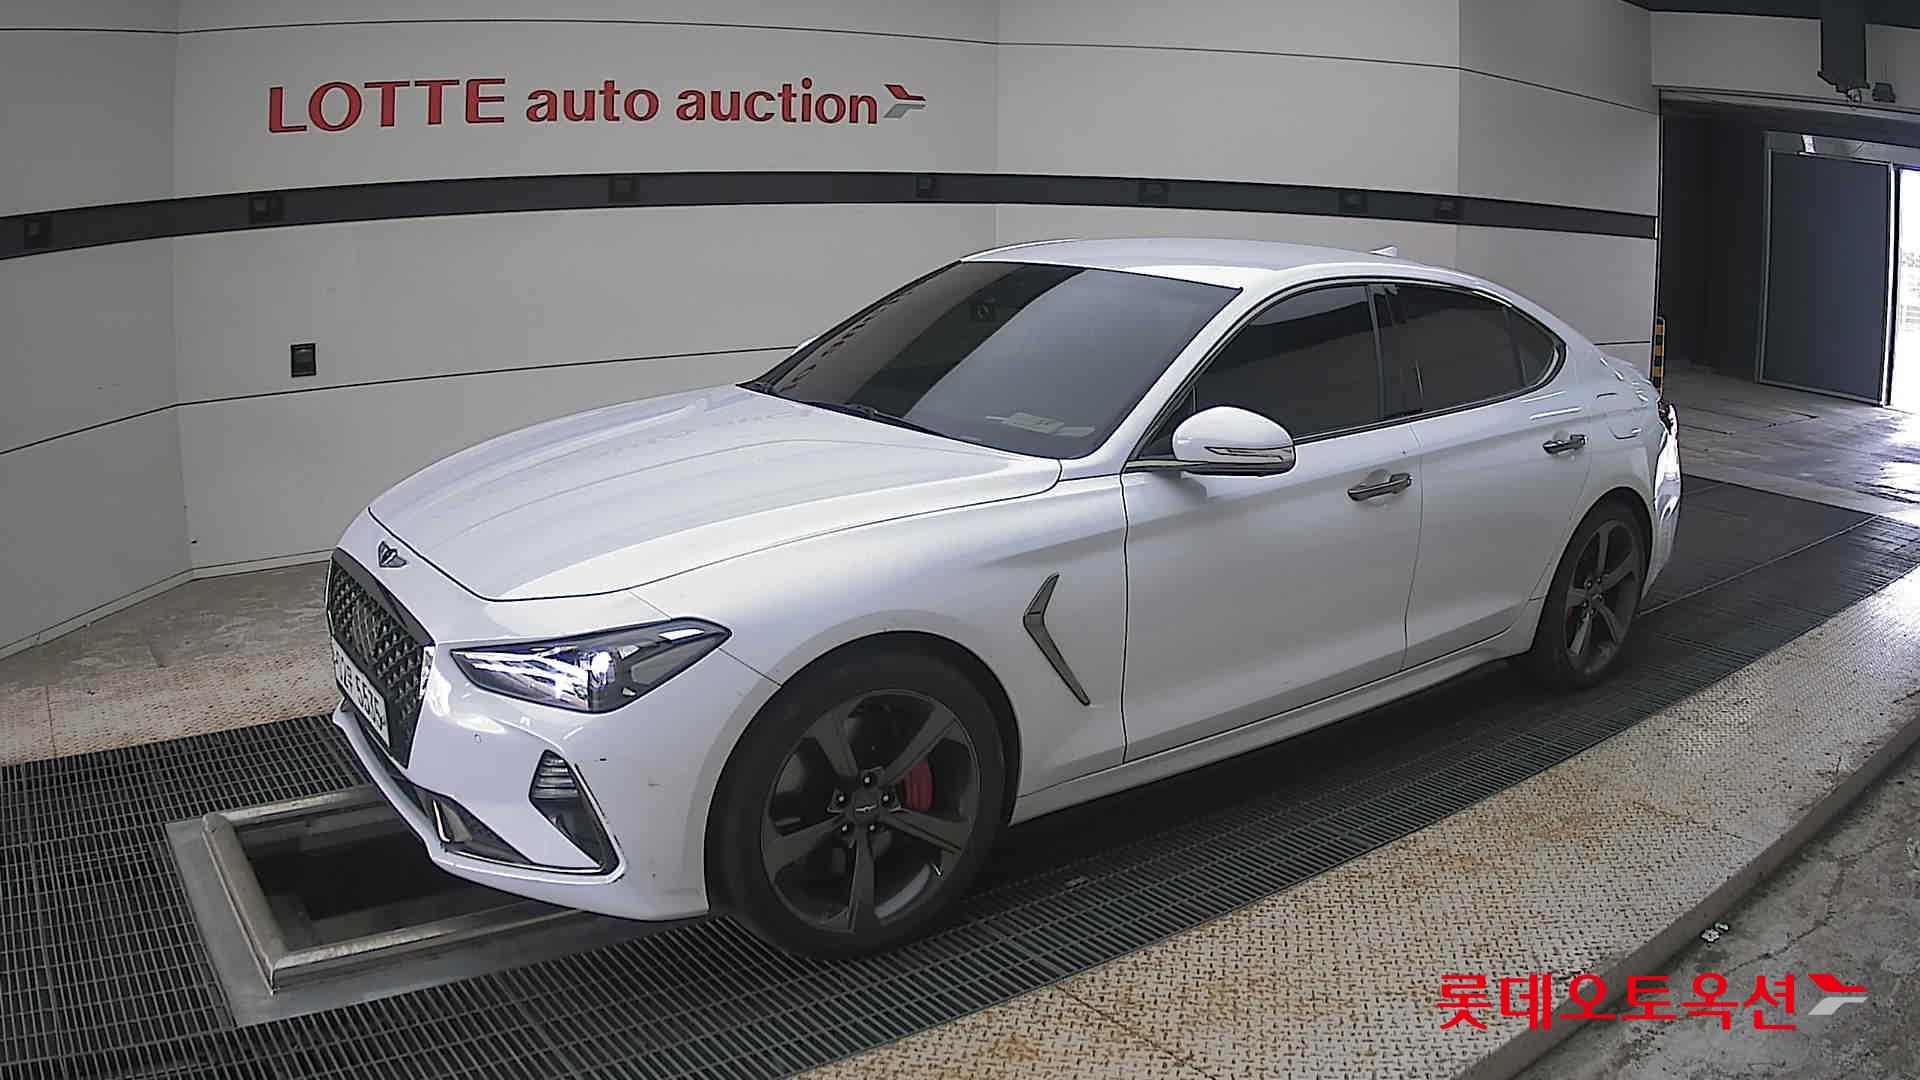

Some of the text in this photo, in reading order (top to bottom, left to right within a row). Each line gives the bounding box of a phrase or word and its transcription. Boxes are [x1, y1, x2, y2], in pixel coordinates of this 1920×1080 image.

[268, 79, 878, 132] LOTTE auto auction
